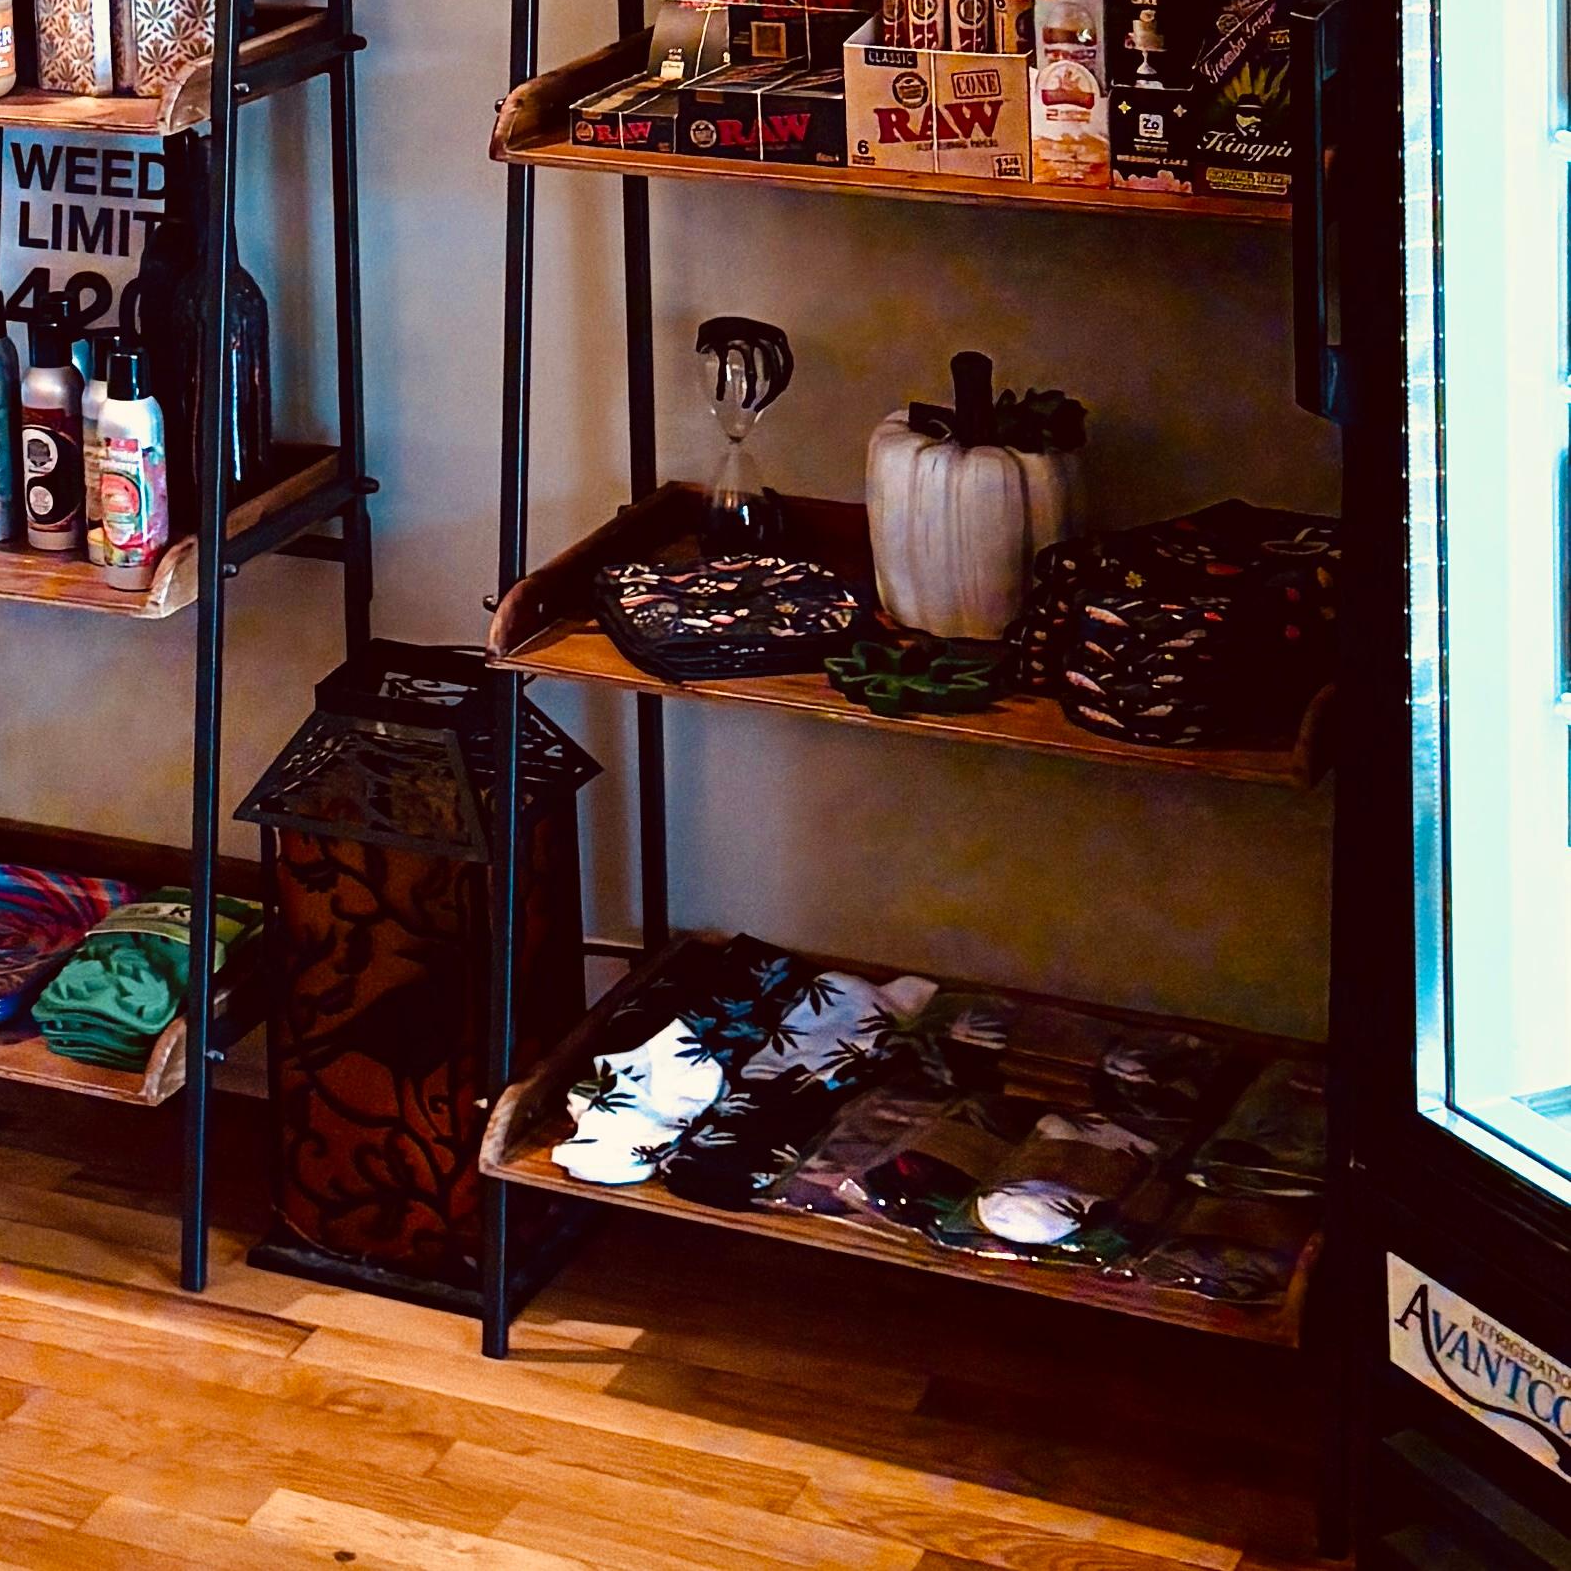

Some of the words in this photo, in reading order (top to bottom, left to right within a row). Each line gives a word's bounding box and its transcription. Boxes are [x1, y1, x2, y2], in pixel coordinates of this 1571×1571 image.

[868, 51, 913, 65] CLASSIC
[956, 72, 997, 95] CONE
[594, 120, 652, 144] RAW
[716, 114, 811, 146] RAW
[873, 100, 1003, 144] RAW
[857, 139, 870, 155] 6
[10, 142, 166, 200] WEED
[19, 201, 165, 257] LIMIT
